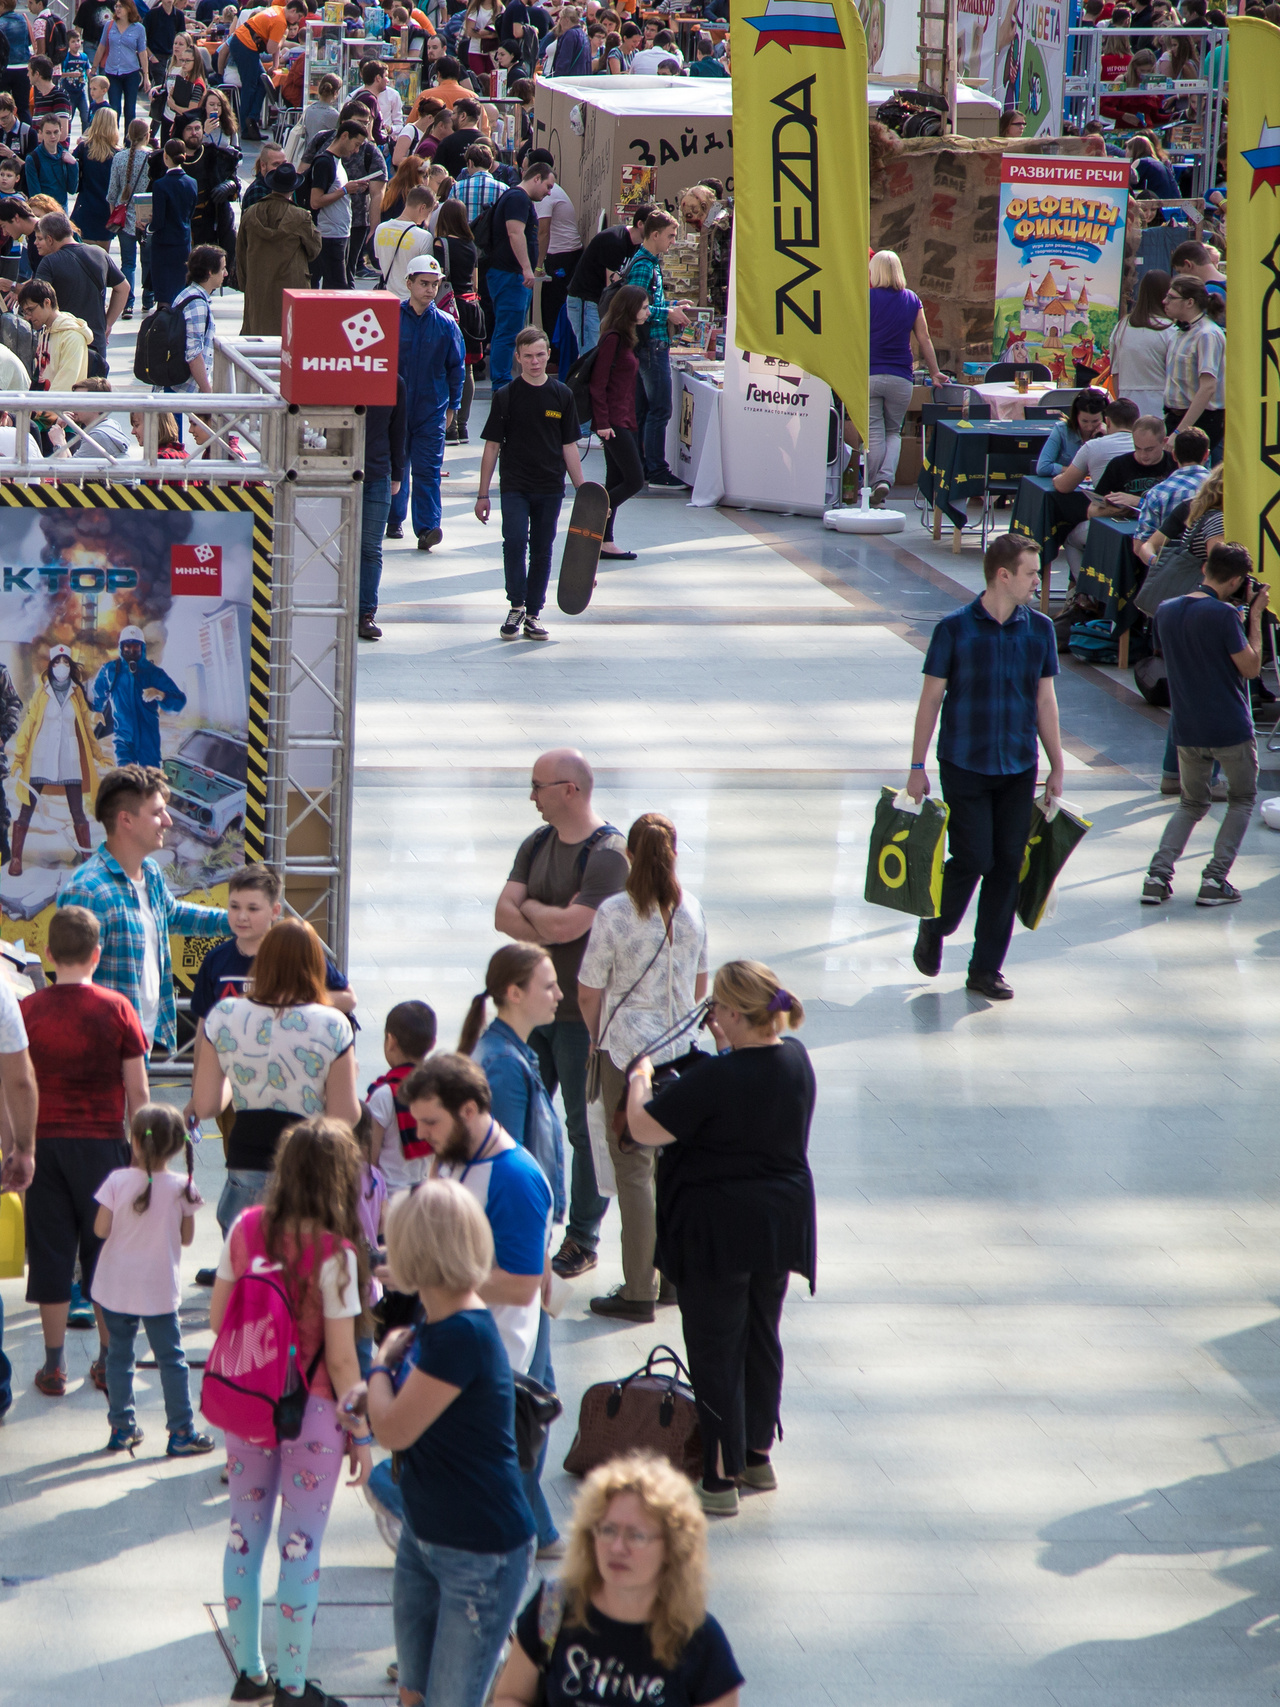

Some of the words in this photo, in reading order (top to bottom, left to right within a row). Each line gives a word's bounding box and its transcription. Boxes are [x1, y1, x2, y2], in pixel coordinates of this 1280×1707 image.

[1010, 165, 1082, 180] РАЗВИТИЕ
[1086, 169, 1123, 181] РЕЧИ
[770, 73, 823, 335] ZVEZDA
[1006, 195, 1120, 226] ФЕФЕКТЫ
[1014, 219, 1109, 245] ФИКЦИИ
[920, 275, 953, 293] GAME
[302, 355, 388, 372] ИНАЧЕ
[746, 382, 809, 407] Геменот
[764, 409, 799, 417] НАСТОЛЬНЫХ
[175, 565, 218, 576] ИНАЧЕ
[210, 1312, 279, 1378] NIKE
